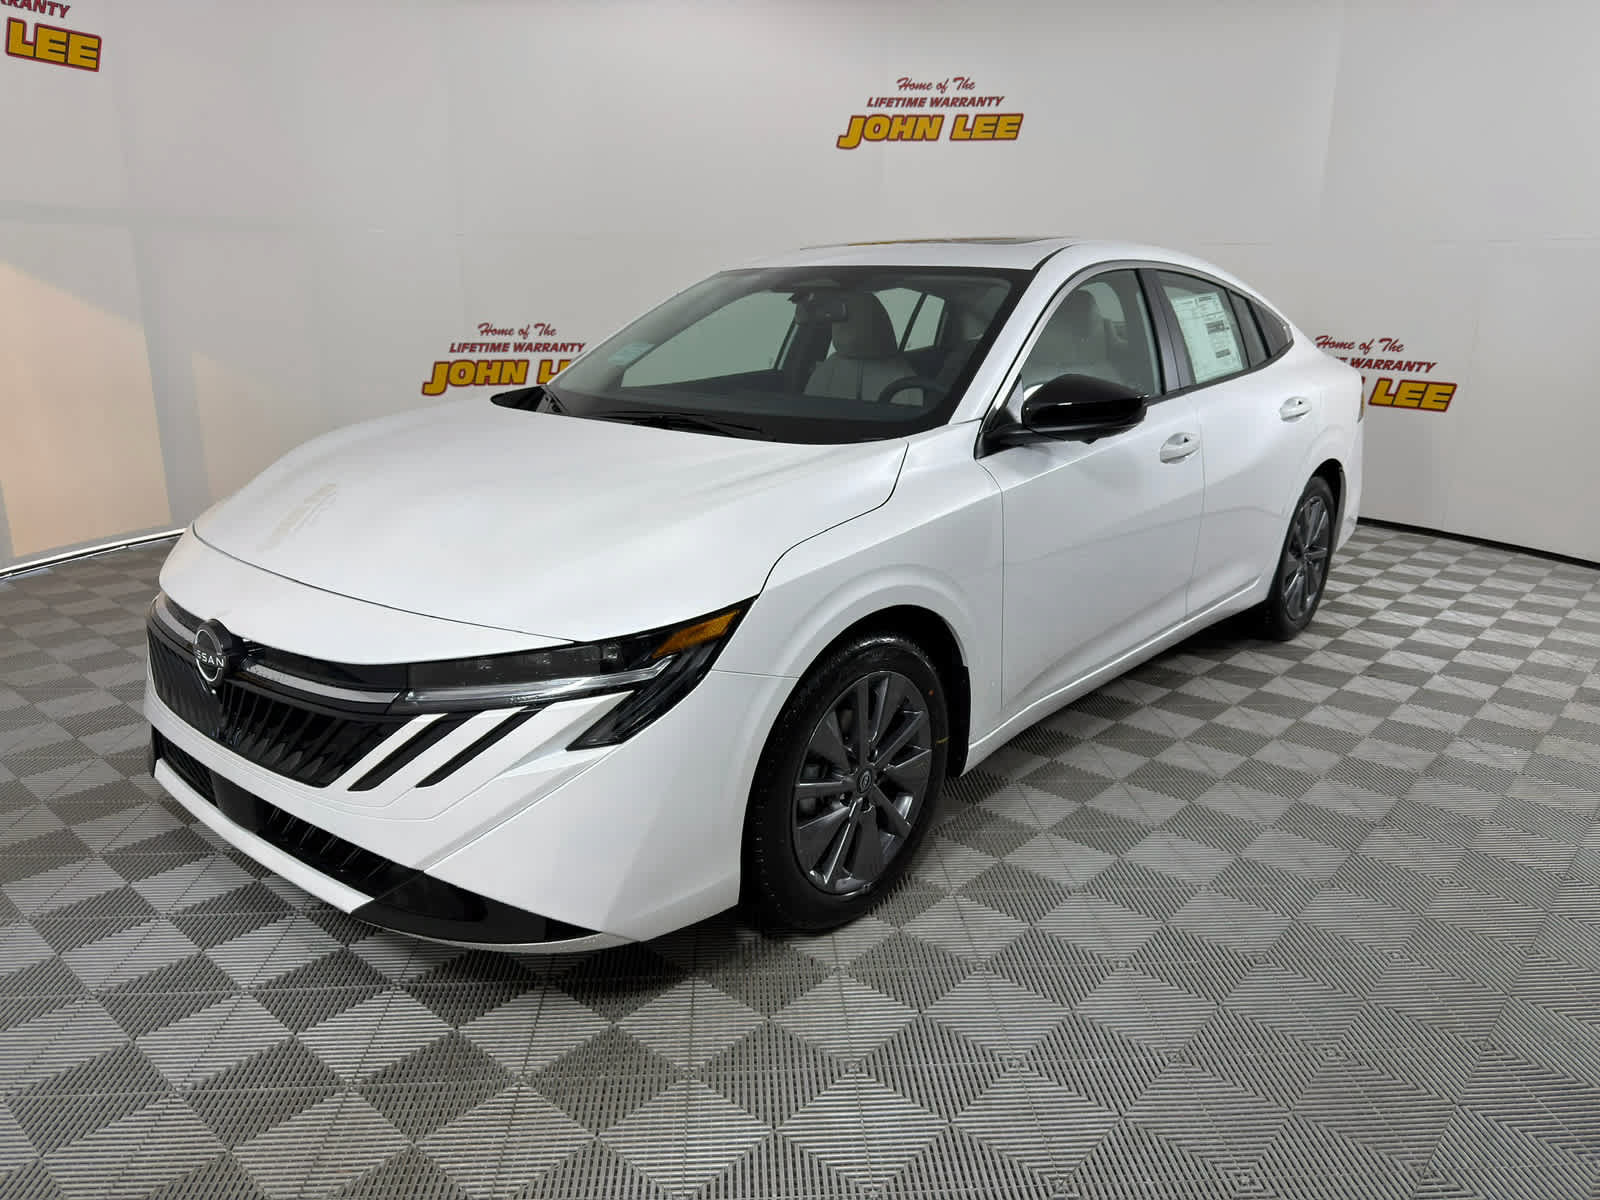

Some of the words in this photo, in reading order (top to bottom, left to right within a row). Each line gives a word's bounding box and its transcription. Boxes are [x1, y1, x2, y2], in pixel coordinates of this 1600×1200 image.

[5, 17, 102, 72] LEE
[897, 77, 933, 91] Home
[936, 78, 950, 94] of
[953, 77, 976, 91] The
[867, 97, 927, 108] LIFETIME
[929, 96, 1004, 108] WARRANTY
[836, 114, 945, 150] JOHN
[949, 113, 1024, 141] LEE
[477, 323, 514, 337] Home
[518, 325, 529, 339] of
[534, 323, 557, 337] The
[449, 342, 510, 353] LIFETIME
[513, 342, 586, 353] WARRANTY
[1315, 335, 1355, 350] Home
[1359, 338, 1375, 355] of
[1379, 338, 1404, 353] The
[1350, 357, 1437, 374] WARRANTY
[421, 359, 530, 396] JOHN
[1368, 377, 1457, 413] LEE
